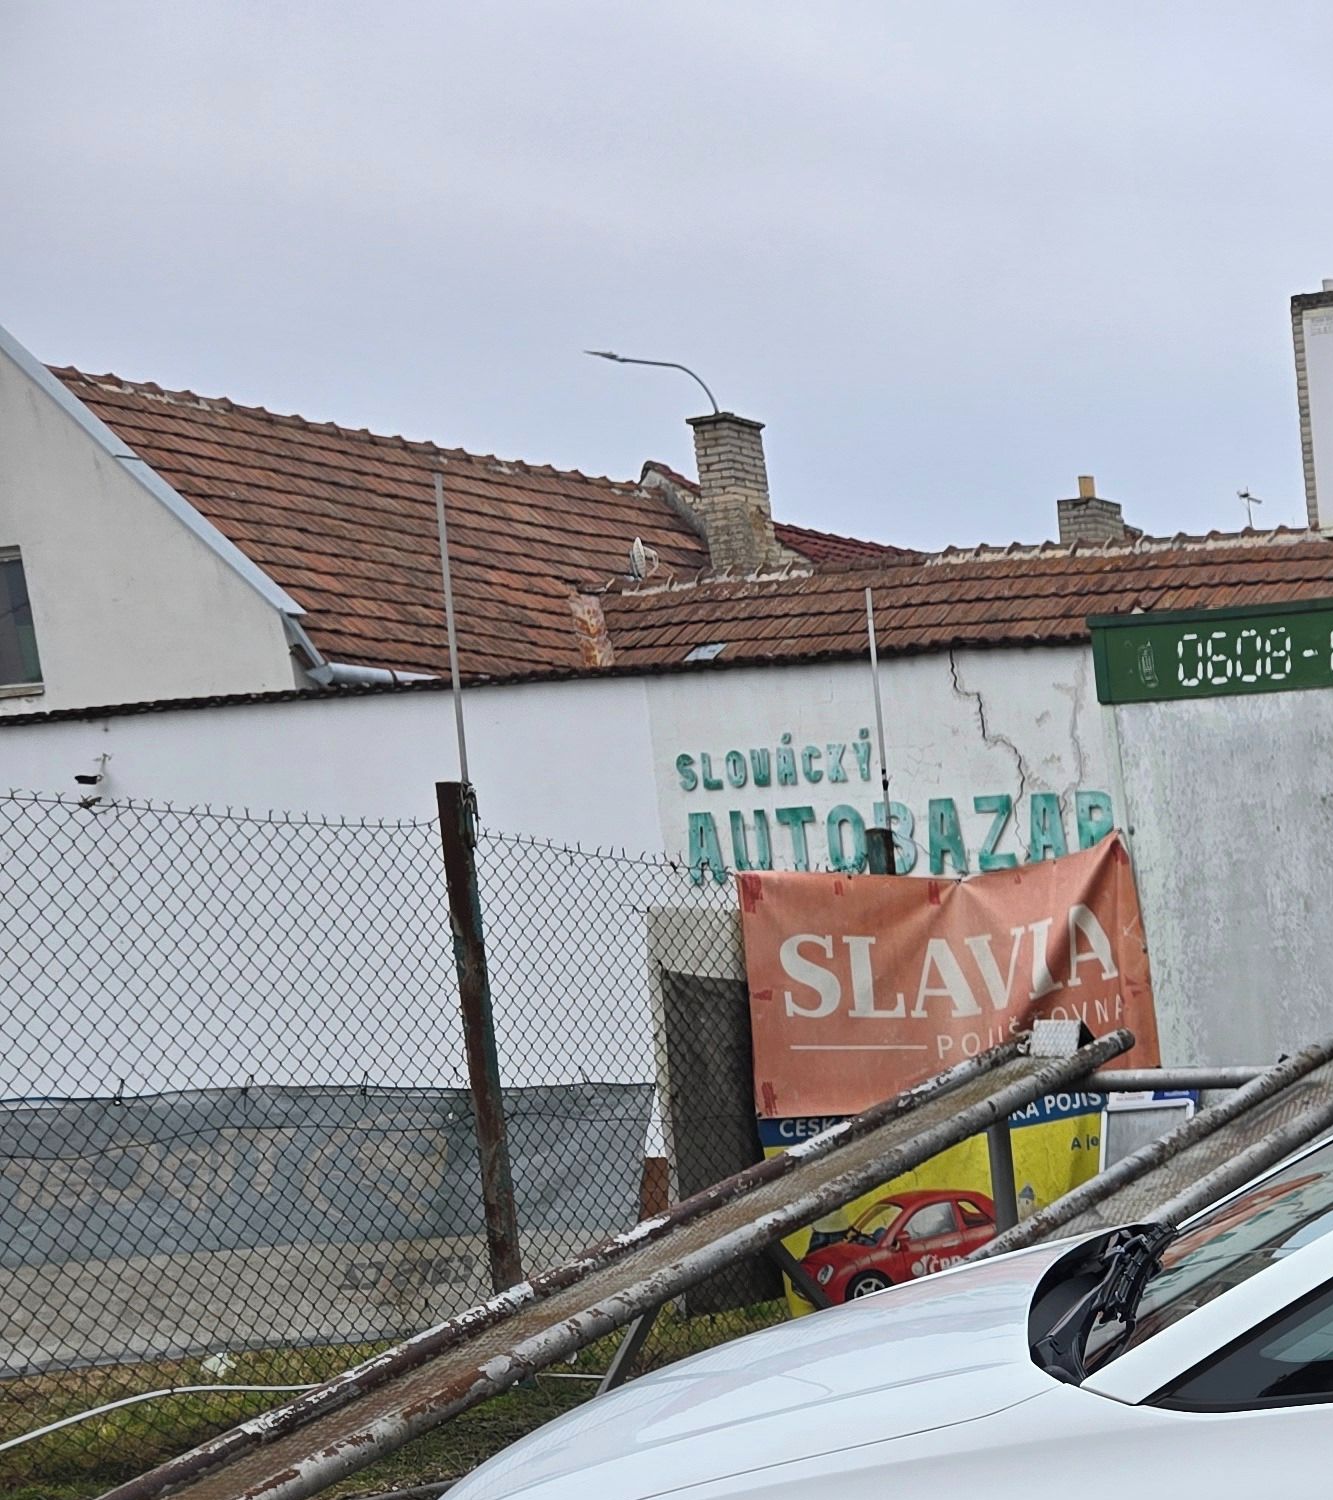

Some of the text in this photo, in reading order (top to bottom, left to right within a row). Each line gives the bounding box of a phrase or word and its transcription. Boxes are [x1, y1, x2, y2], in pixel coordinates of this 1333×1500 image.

[1177, 626, 1292, 687] 0608
[675, 727, 872, 792] SLOVÁCKÝ
[779, 903, 1119, 1019] SLAVIA
